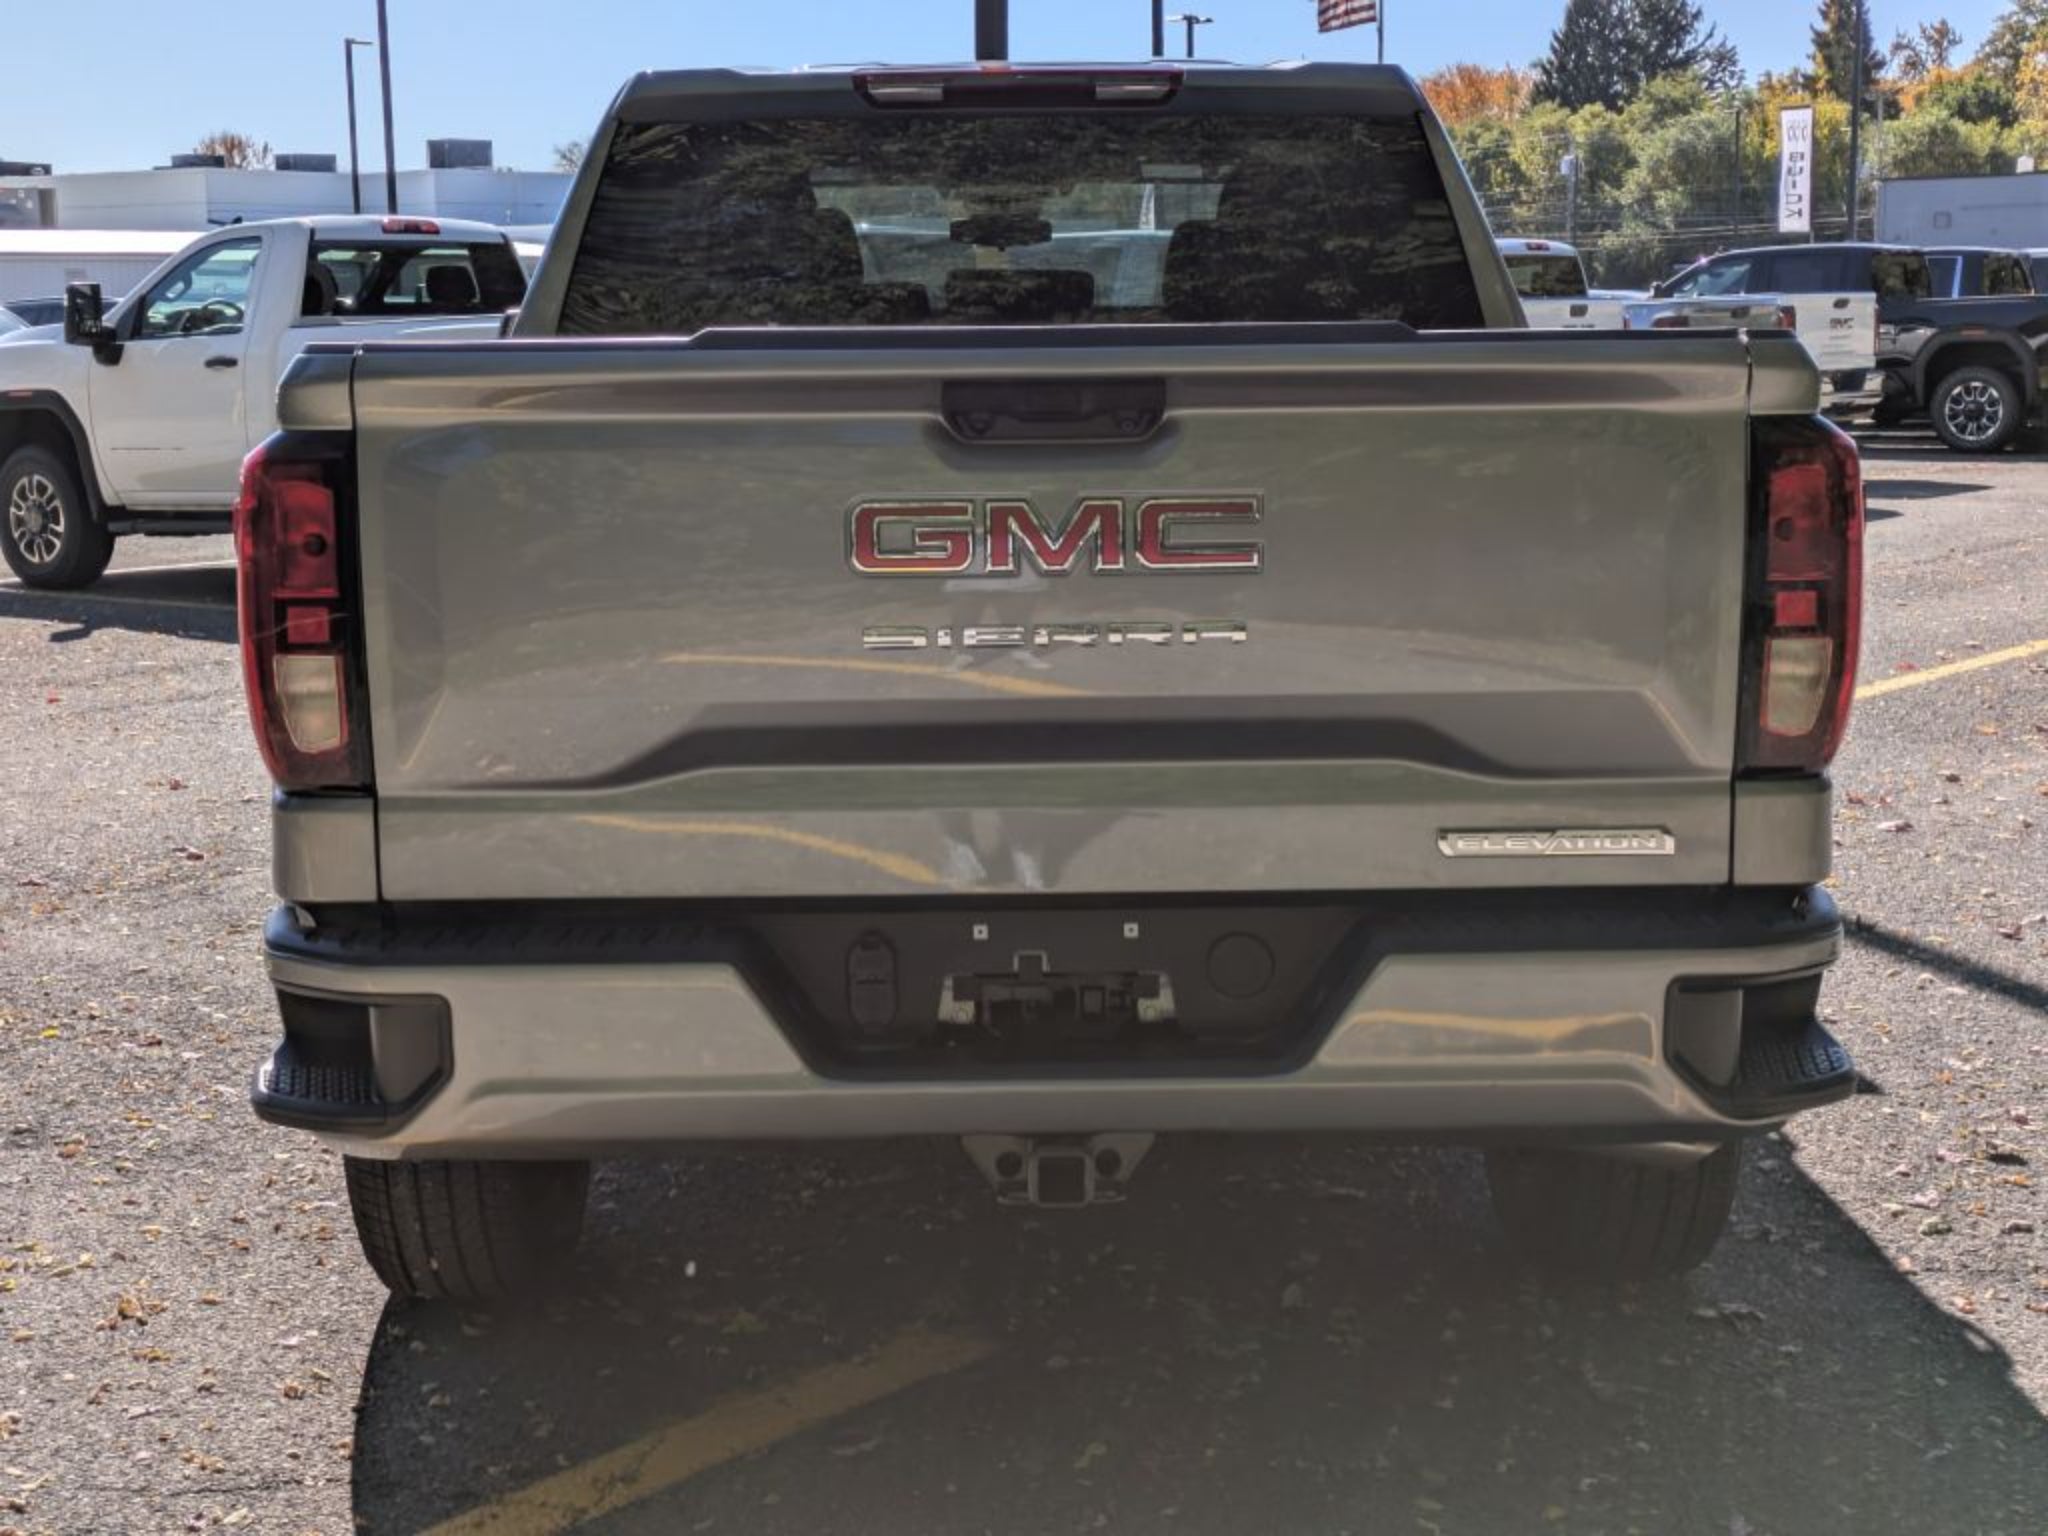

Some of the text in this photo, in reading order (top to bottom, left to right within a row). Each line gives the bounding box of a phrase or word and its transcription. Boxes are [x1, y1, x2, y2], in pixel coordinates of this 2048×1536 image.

[850, 498, 1262, 574] GMC
[862, 622, 1248, 649] SIERRA
[1456, 834, 1657, 849] ELEVATION
